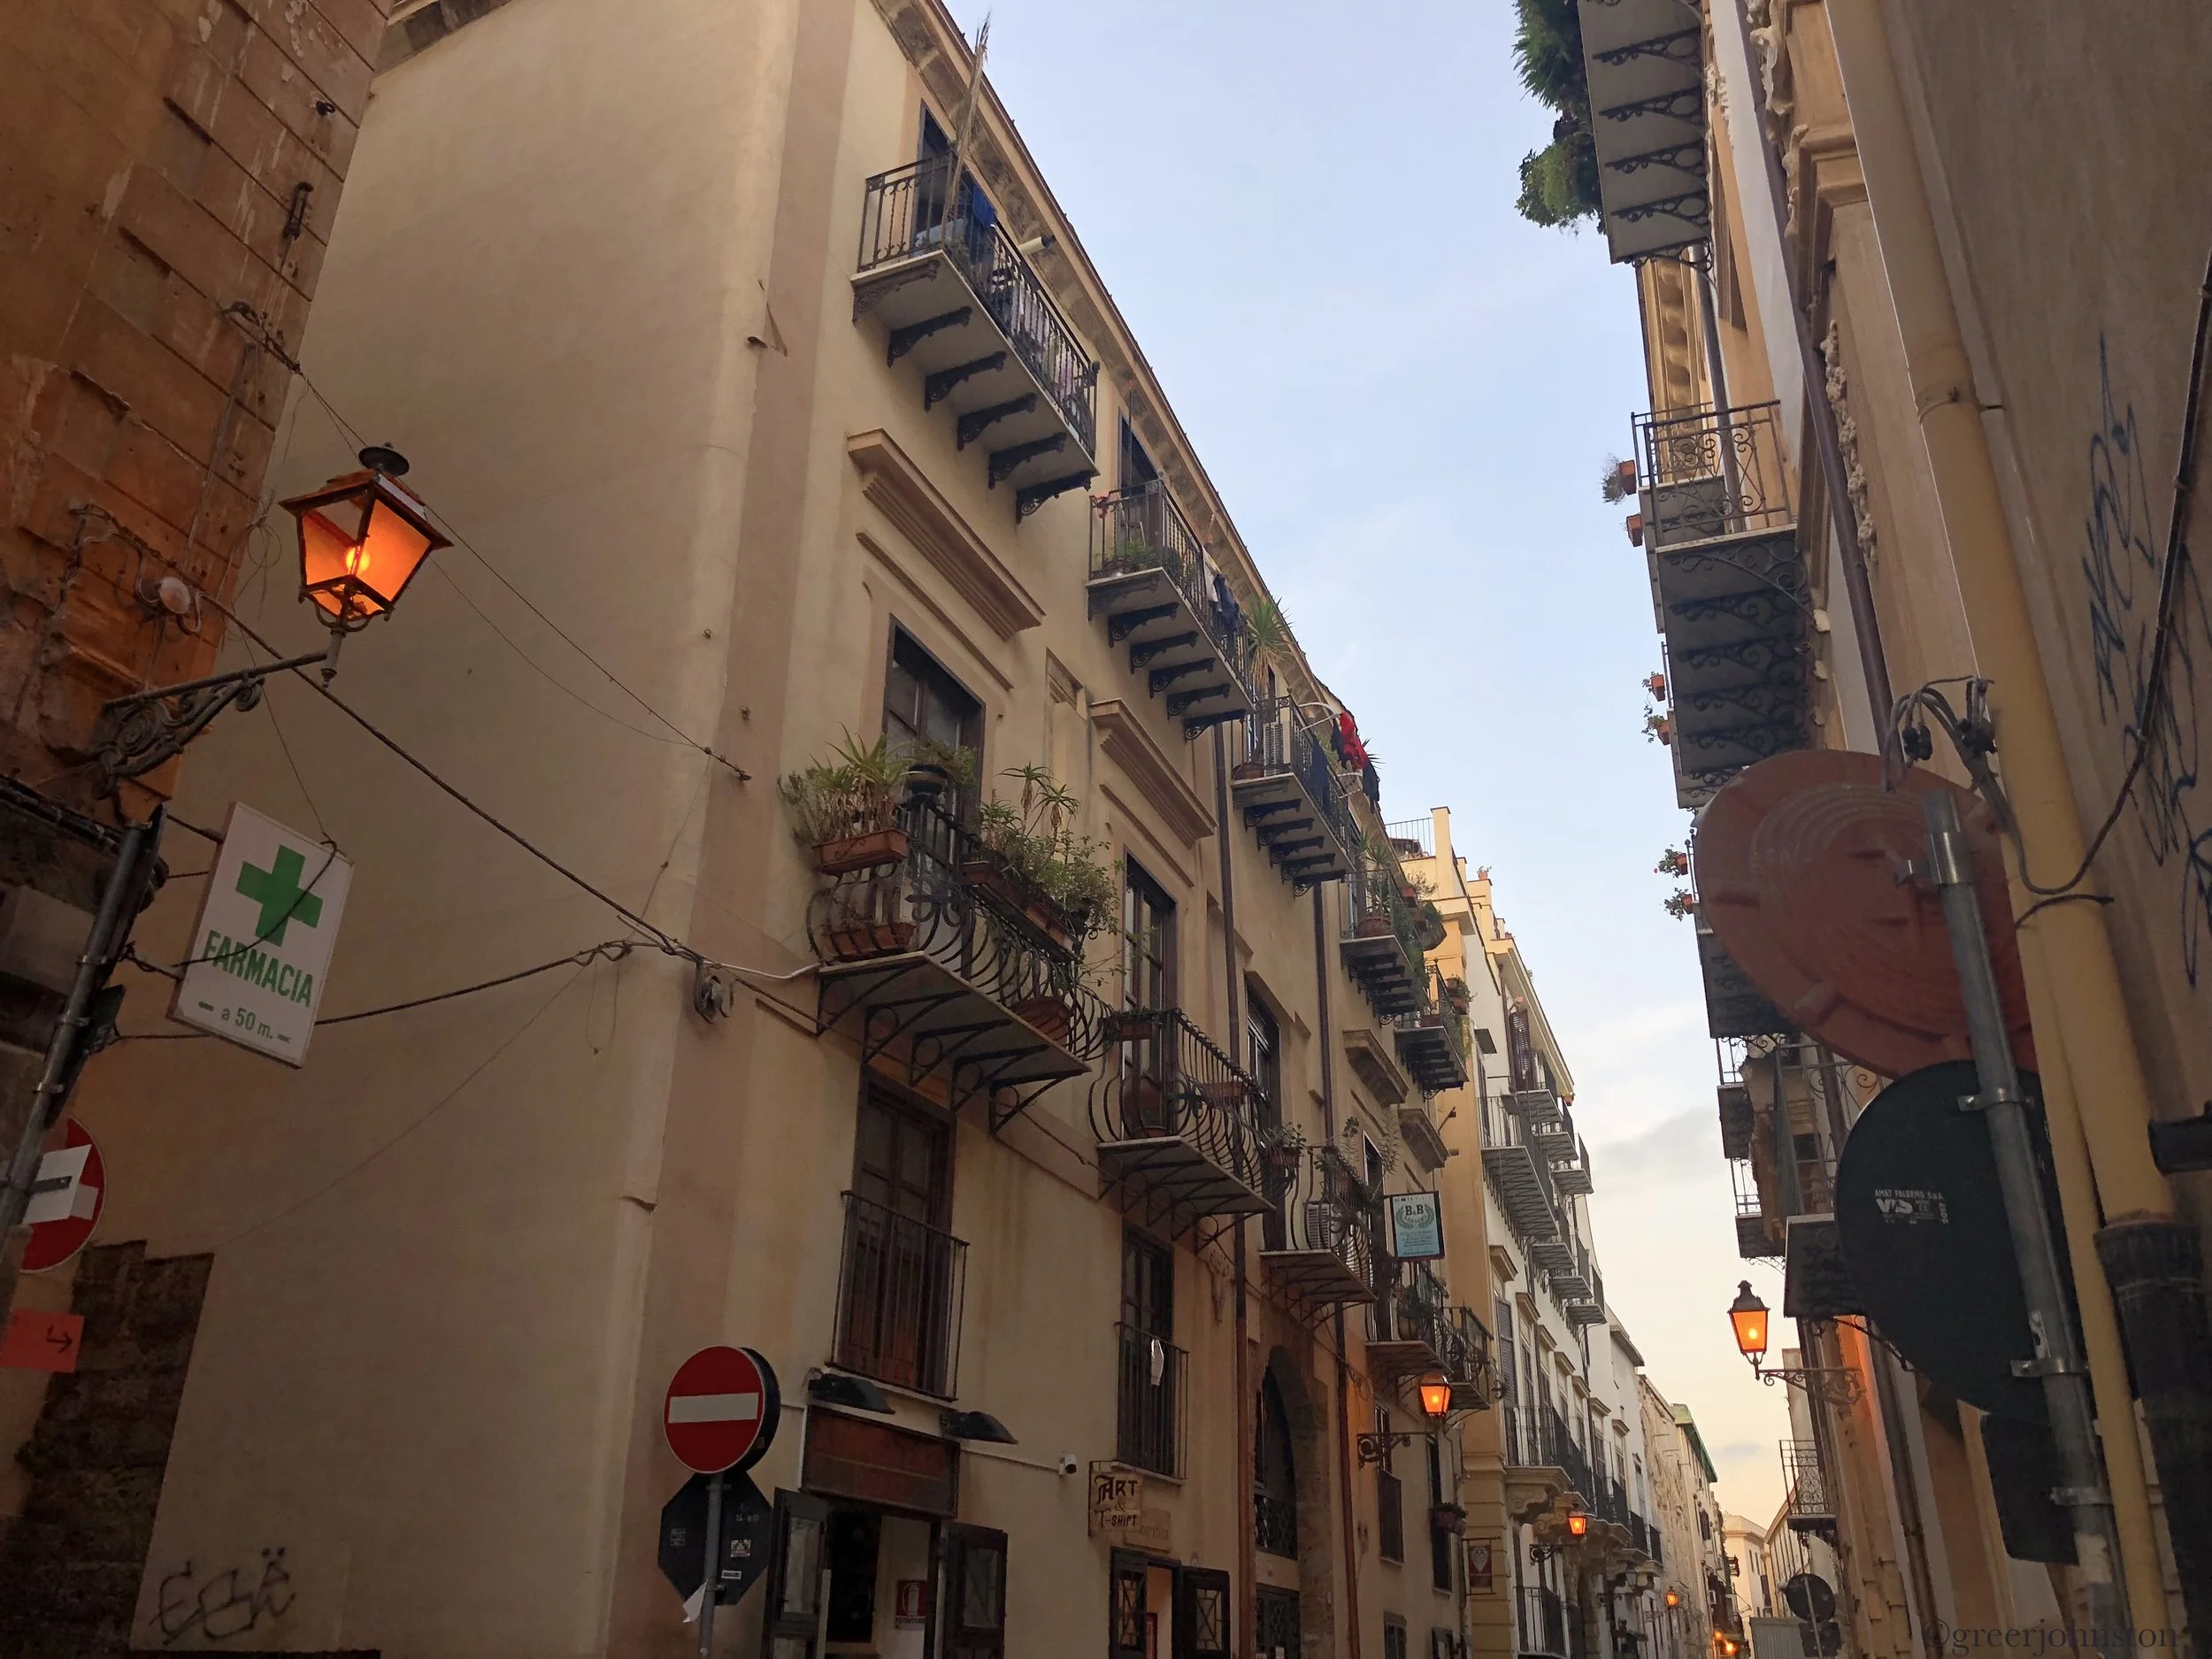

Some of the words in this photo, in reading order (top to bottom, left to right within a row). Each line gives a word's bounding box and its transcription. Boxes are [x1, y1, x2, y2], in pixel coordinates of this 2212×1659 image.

[202, 930, 312, 1008] FARMACIA
[221, 1009, 230, 1021] a
[235, 1007, 256, 1031] 50
[257, 1023, 273, 1040] m.
[1895, 1189, 1924, 1198] PALERMO
[1094, 1473, 1138, 1505] ART
